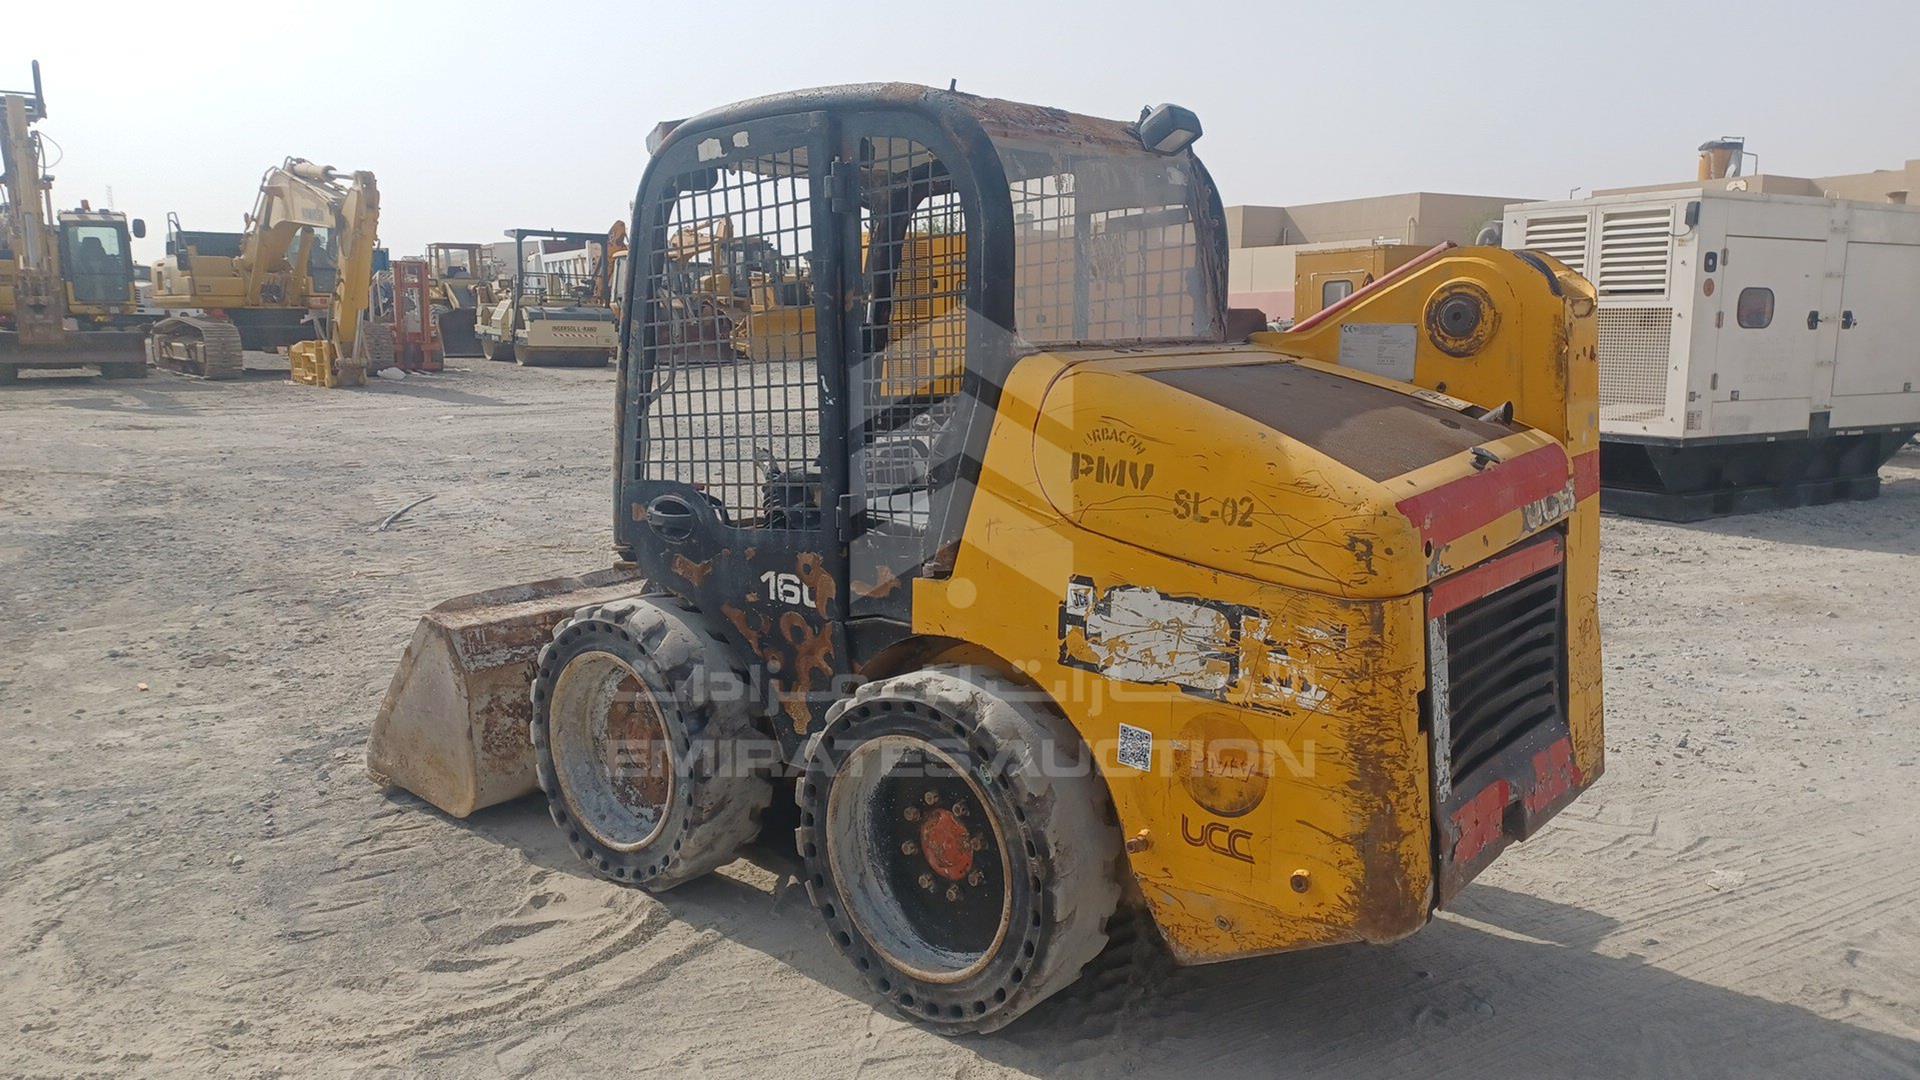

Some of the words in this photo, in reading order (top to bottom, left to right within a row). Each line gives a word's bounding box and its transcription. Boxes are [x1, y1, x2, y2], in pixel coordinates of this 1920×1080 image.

[1070, 451, 1154, 492] PMV
[1172, 488, 1255, 528] SL-02
[1181, 813, 1255, 865] UCC
